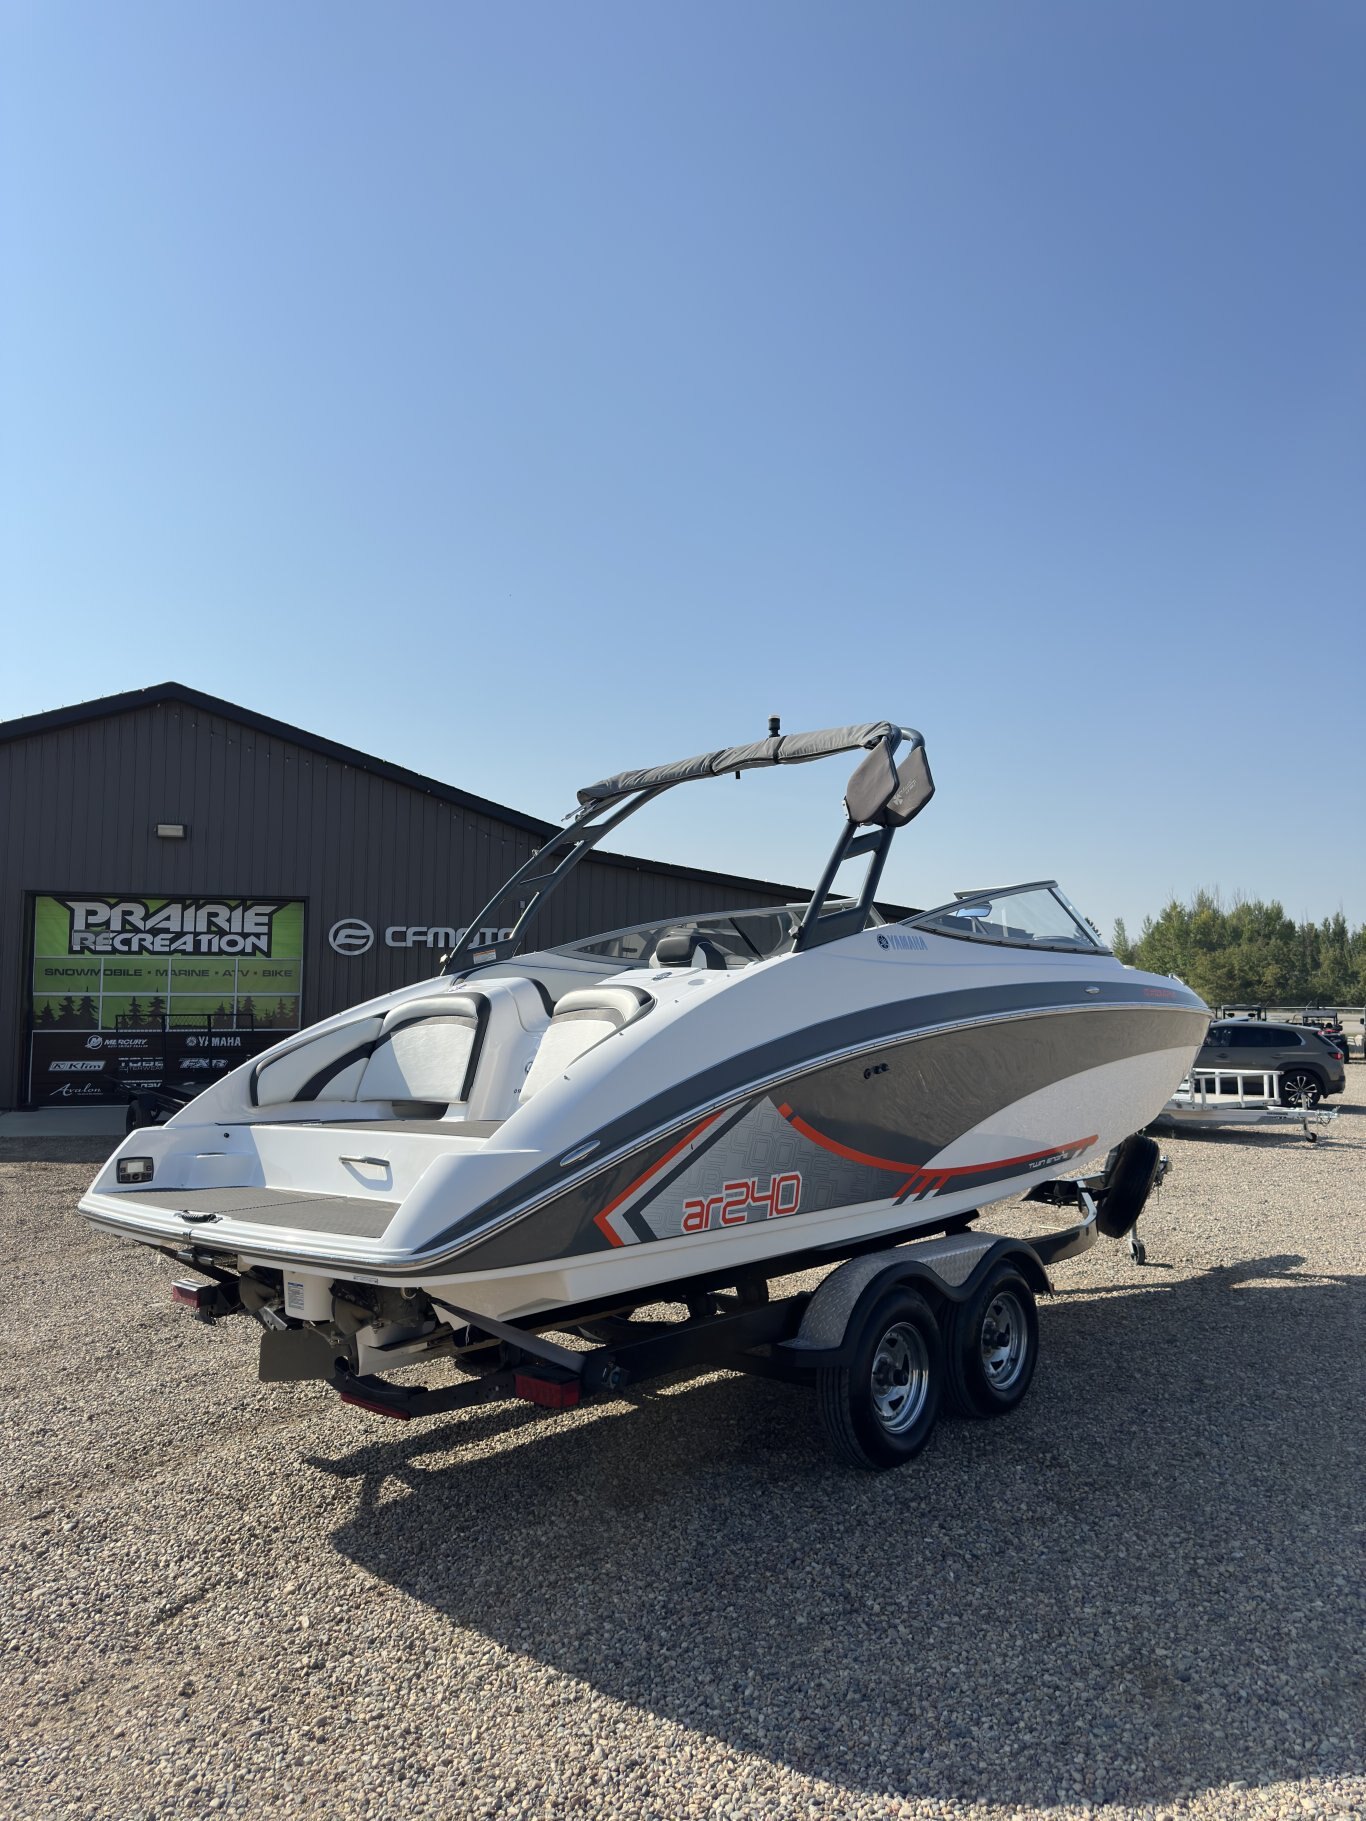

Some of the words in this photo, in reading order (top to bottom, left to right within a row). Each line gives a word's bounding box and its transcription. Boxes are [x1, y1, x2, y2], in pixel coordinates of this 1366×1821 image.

[65, 901, 278, 933] PRAIRIE
[73, 931, 268, 953] RECREATION
[887, 935, 928, 950] YAMAHA
[44, 967, 143, 977] SNOWMOBILE
[155, 968, 209, 977] MARINE
[222, 968, 249, 977] ATV
[262, 969, 292, 977] BIKE
[104, 1038, 148, 1046] MERCURY
[49, 1082, 102, 1097] Avalon
[681, 1171, 802, 1234] ar240
